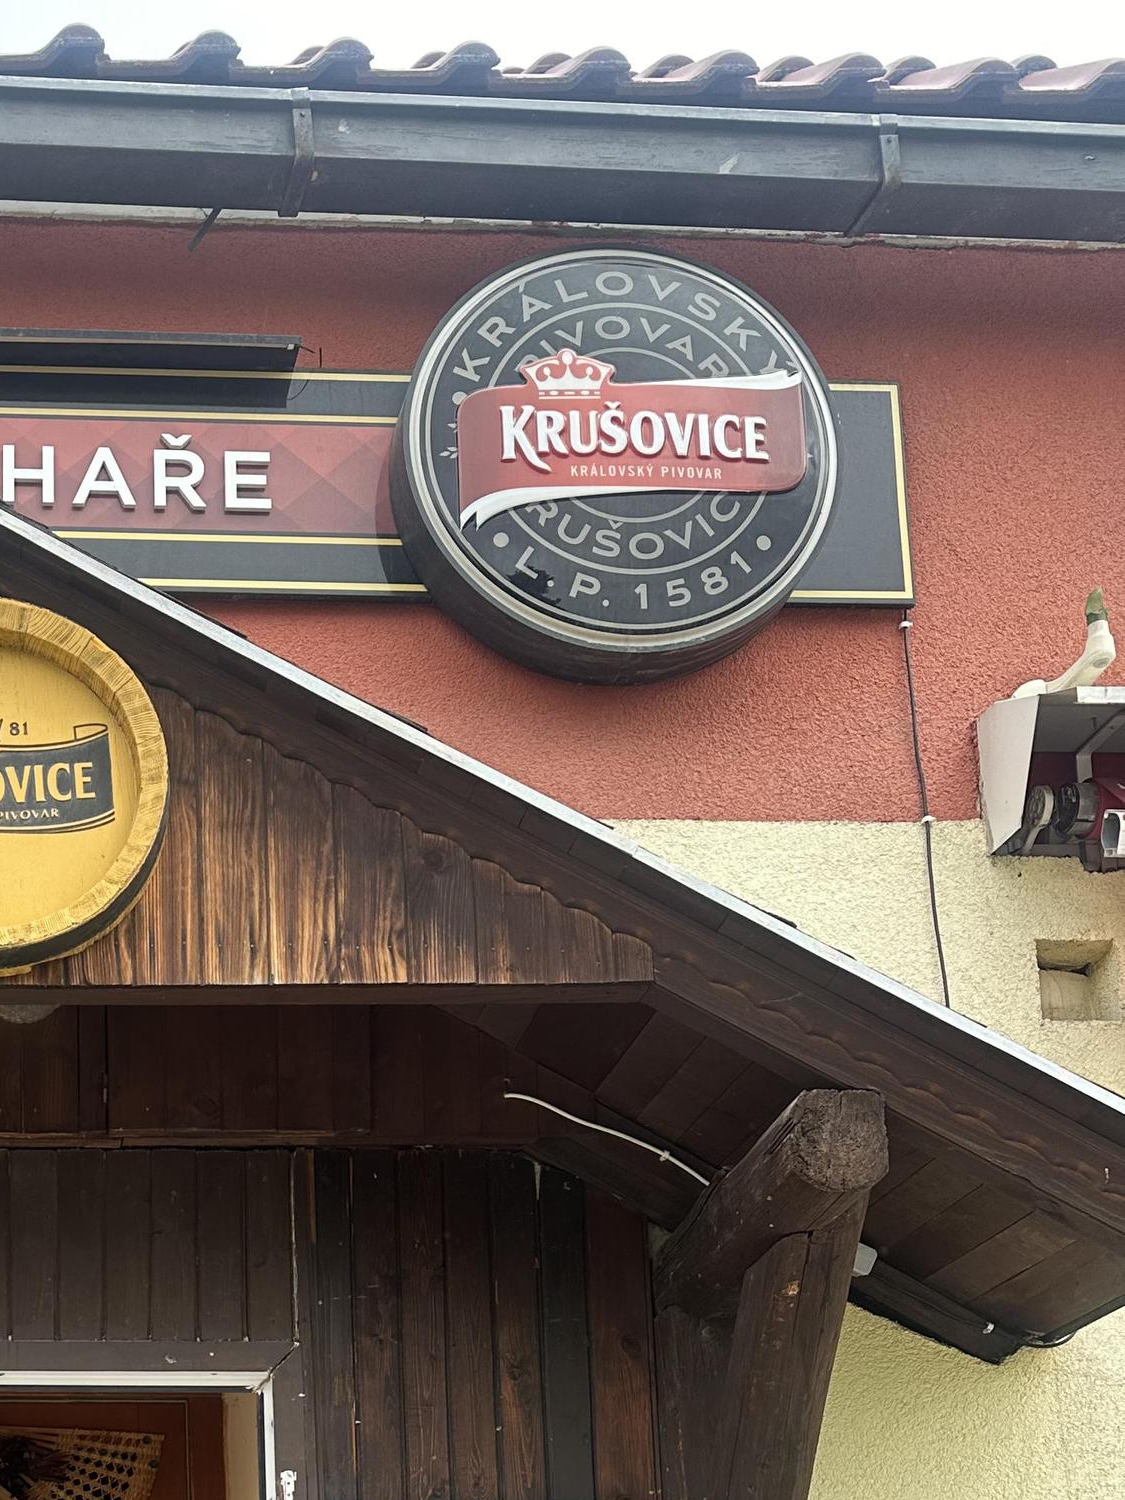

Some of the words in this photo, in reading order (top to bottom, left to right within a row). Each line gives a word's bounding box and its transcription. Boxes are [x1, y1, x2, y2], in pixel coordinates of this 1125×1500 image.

[499, 401, 771, 473] KRUŠOVICE
[570, 463, 654, 478] KRÁLOVSKÝ
[661, 466, 723, 480] PIVOVAR
[525, 491, 741, 560] RUŠOVIC
[634, 550, 753, 610] 1581
[9, 721, 29, 736] 81
